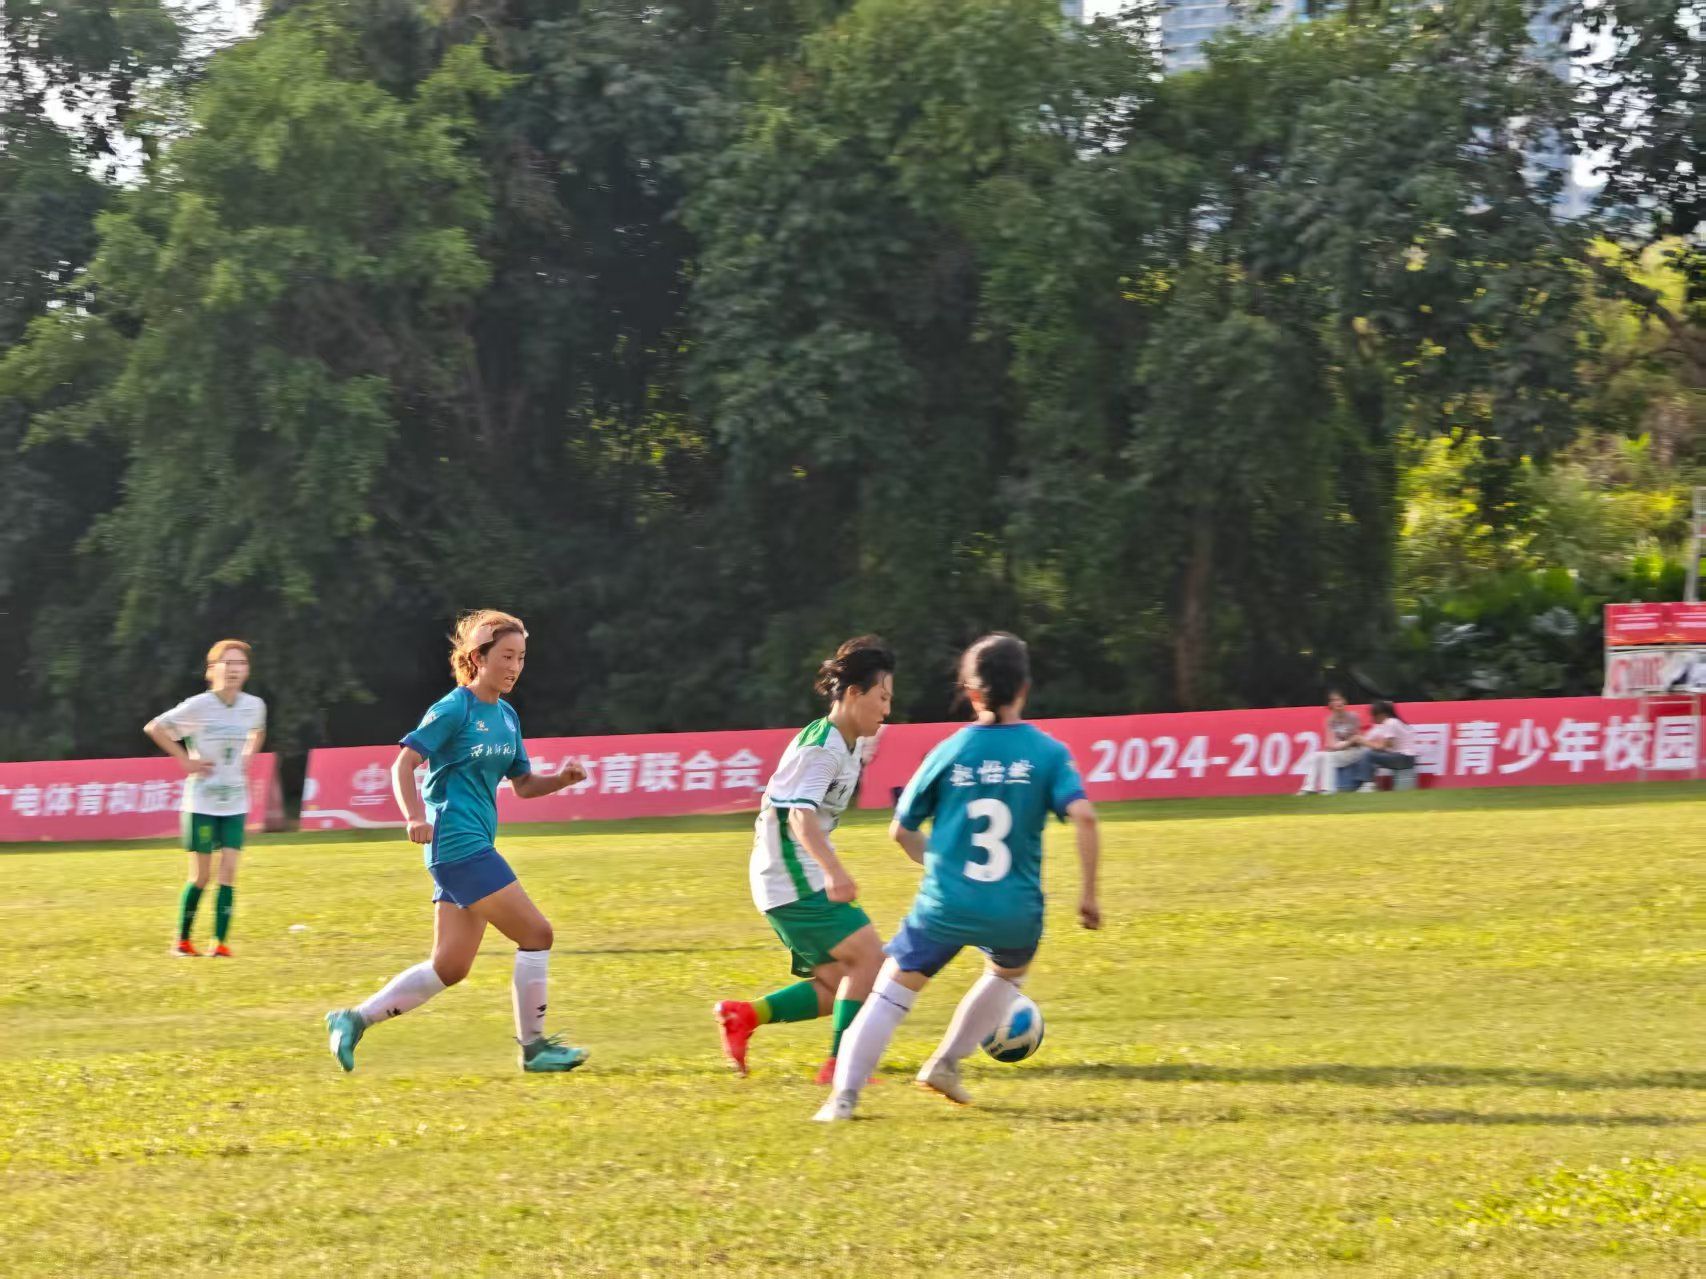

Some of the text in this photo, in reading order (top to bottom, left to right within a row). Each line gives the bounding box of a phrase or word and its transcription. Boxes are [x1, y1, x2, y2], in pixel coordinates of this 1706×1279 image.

[1087, 731, 1321, 782] 2024-202
[0, 780, 185, 816] 电体育和旅
[963, 798, 1012, 882] 3
